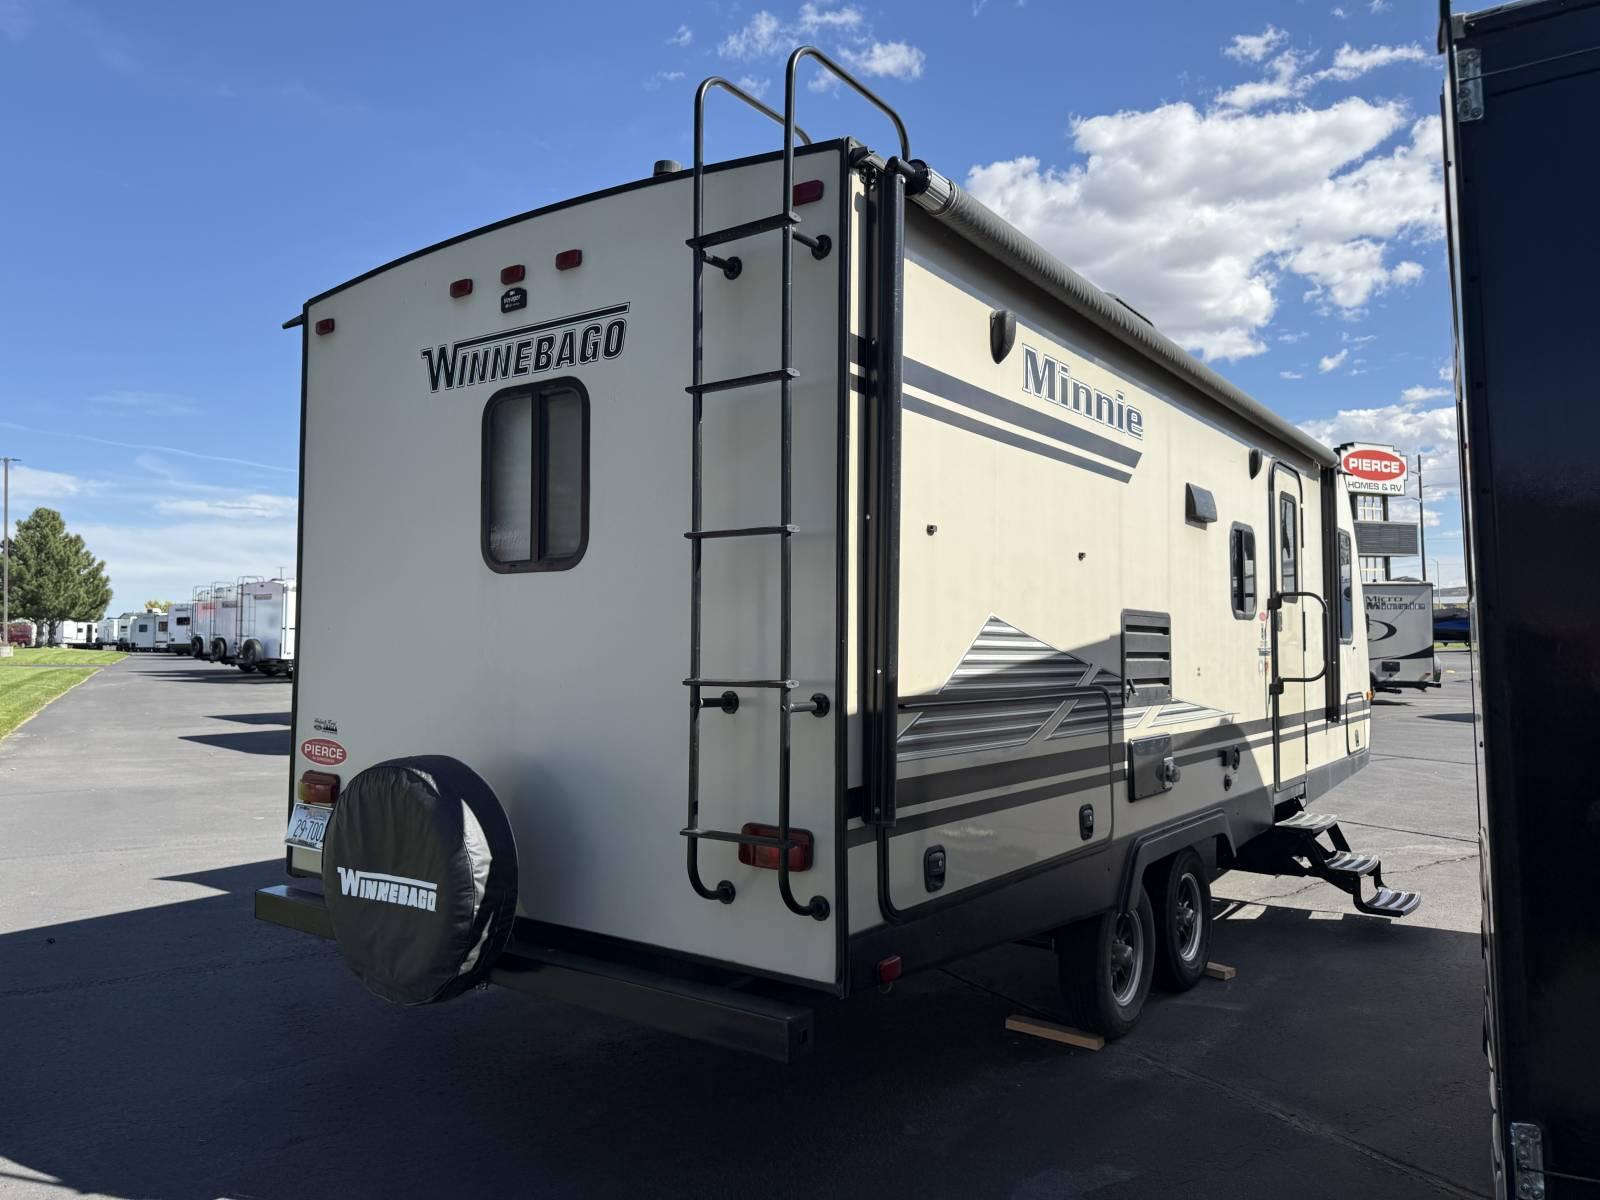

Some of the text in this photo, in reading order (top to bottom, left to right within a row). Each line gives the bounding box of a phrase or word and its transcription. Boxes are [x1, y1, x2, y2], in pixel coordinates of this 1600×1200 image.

[1022, 343, 1144, 440] Minnie
[1348, 457, 1400, 473] PIERCE
[1347, 481, 1379, 490] HOMES
[1390, 484, 1402, 492] RV
[304, 743, 344, 760] PIERCE
